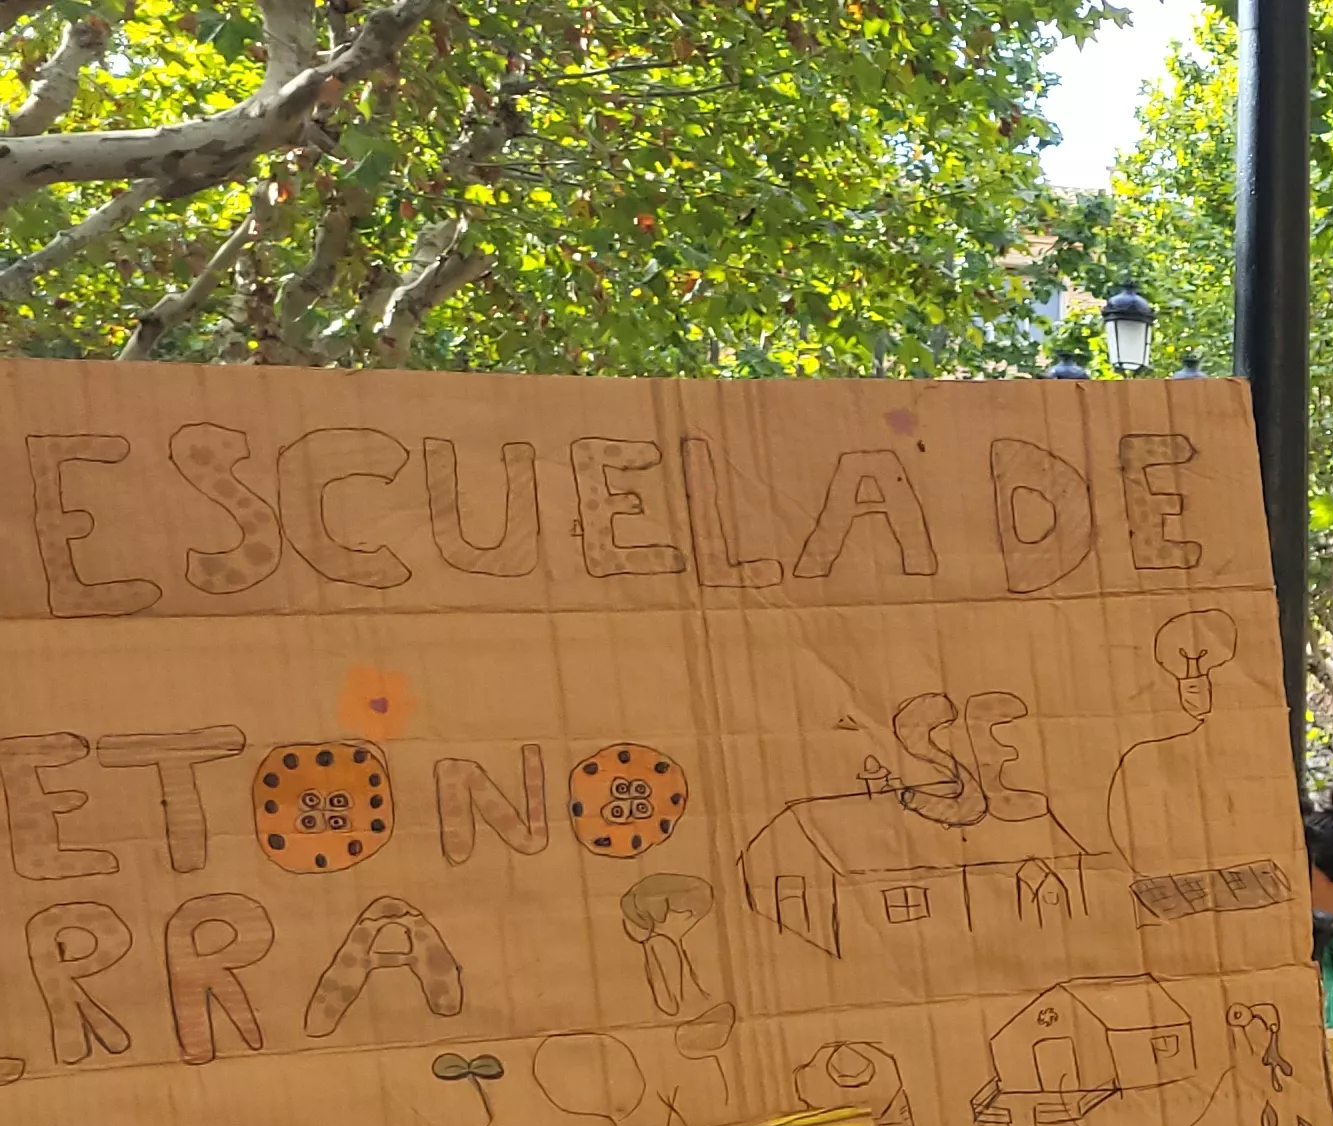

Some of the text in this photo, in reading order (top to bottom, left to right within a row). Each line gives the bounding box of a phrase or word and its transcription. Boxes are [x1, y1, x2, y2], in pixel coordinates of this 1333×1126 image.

[26, 423, 1202, 618] ESCUELA DE
[435, 743, 688, 866] NO
[893, 691, 1049, 828] SE
[0, 892, 464, 1086] RRA
